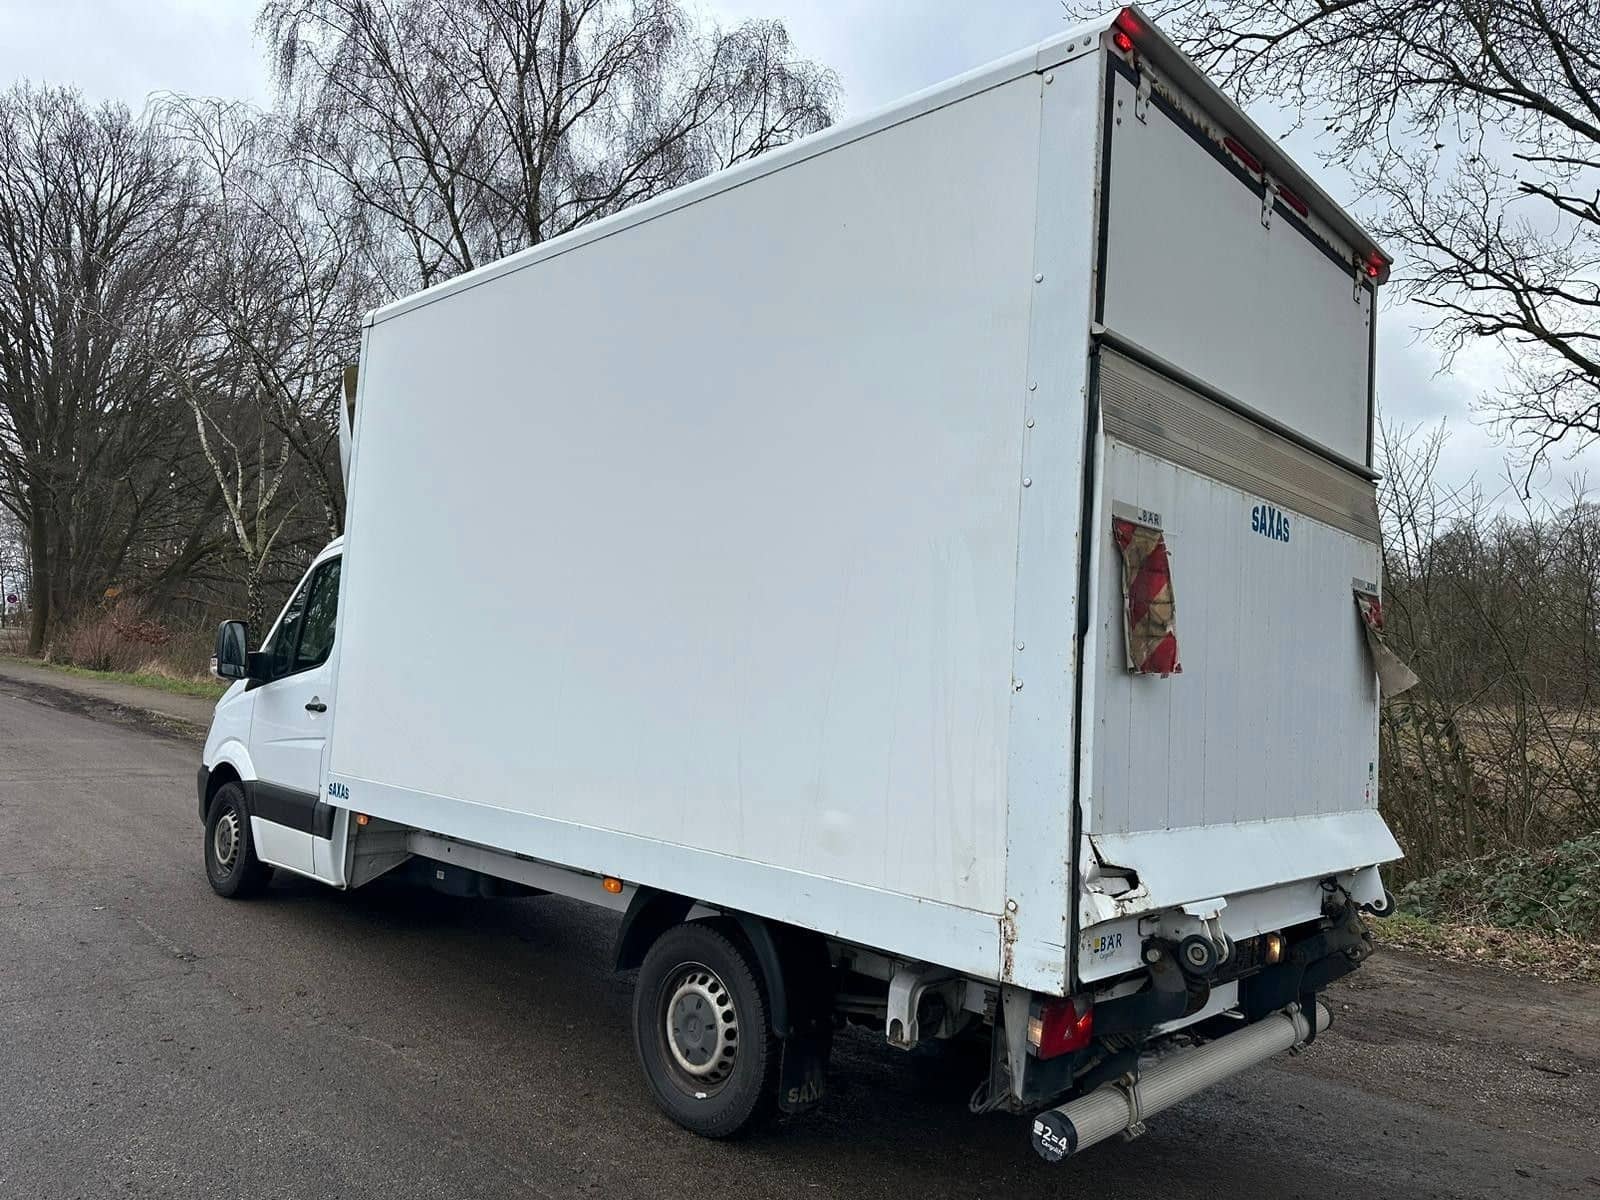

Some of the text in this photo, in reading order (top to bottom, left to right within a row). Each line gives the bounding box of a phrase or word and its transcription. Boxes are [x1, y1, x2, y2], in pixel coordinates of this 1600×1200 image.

[1252, 505, 1290, 543] SAXAS
[328, 782, 350, 800] SAXAS
[1100, 933, 1122, 952] BÄR
[1042, 1126, 1067, 1150] 2=4
